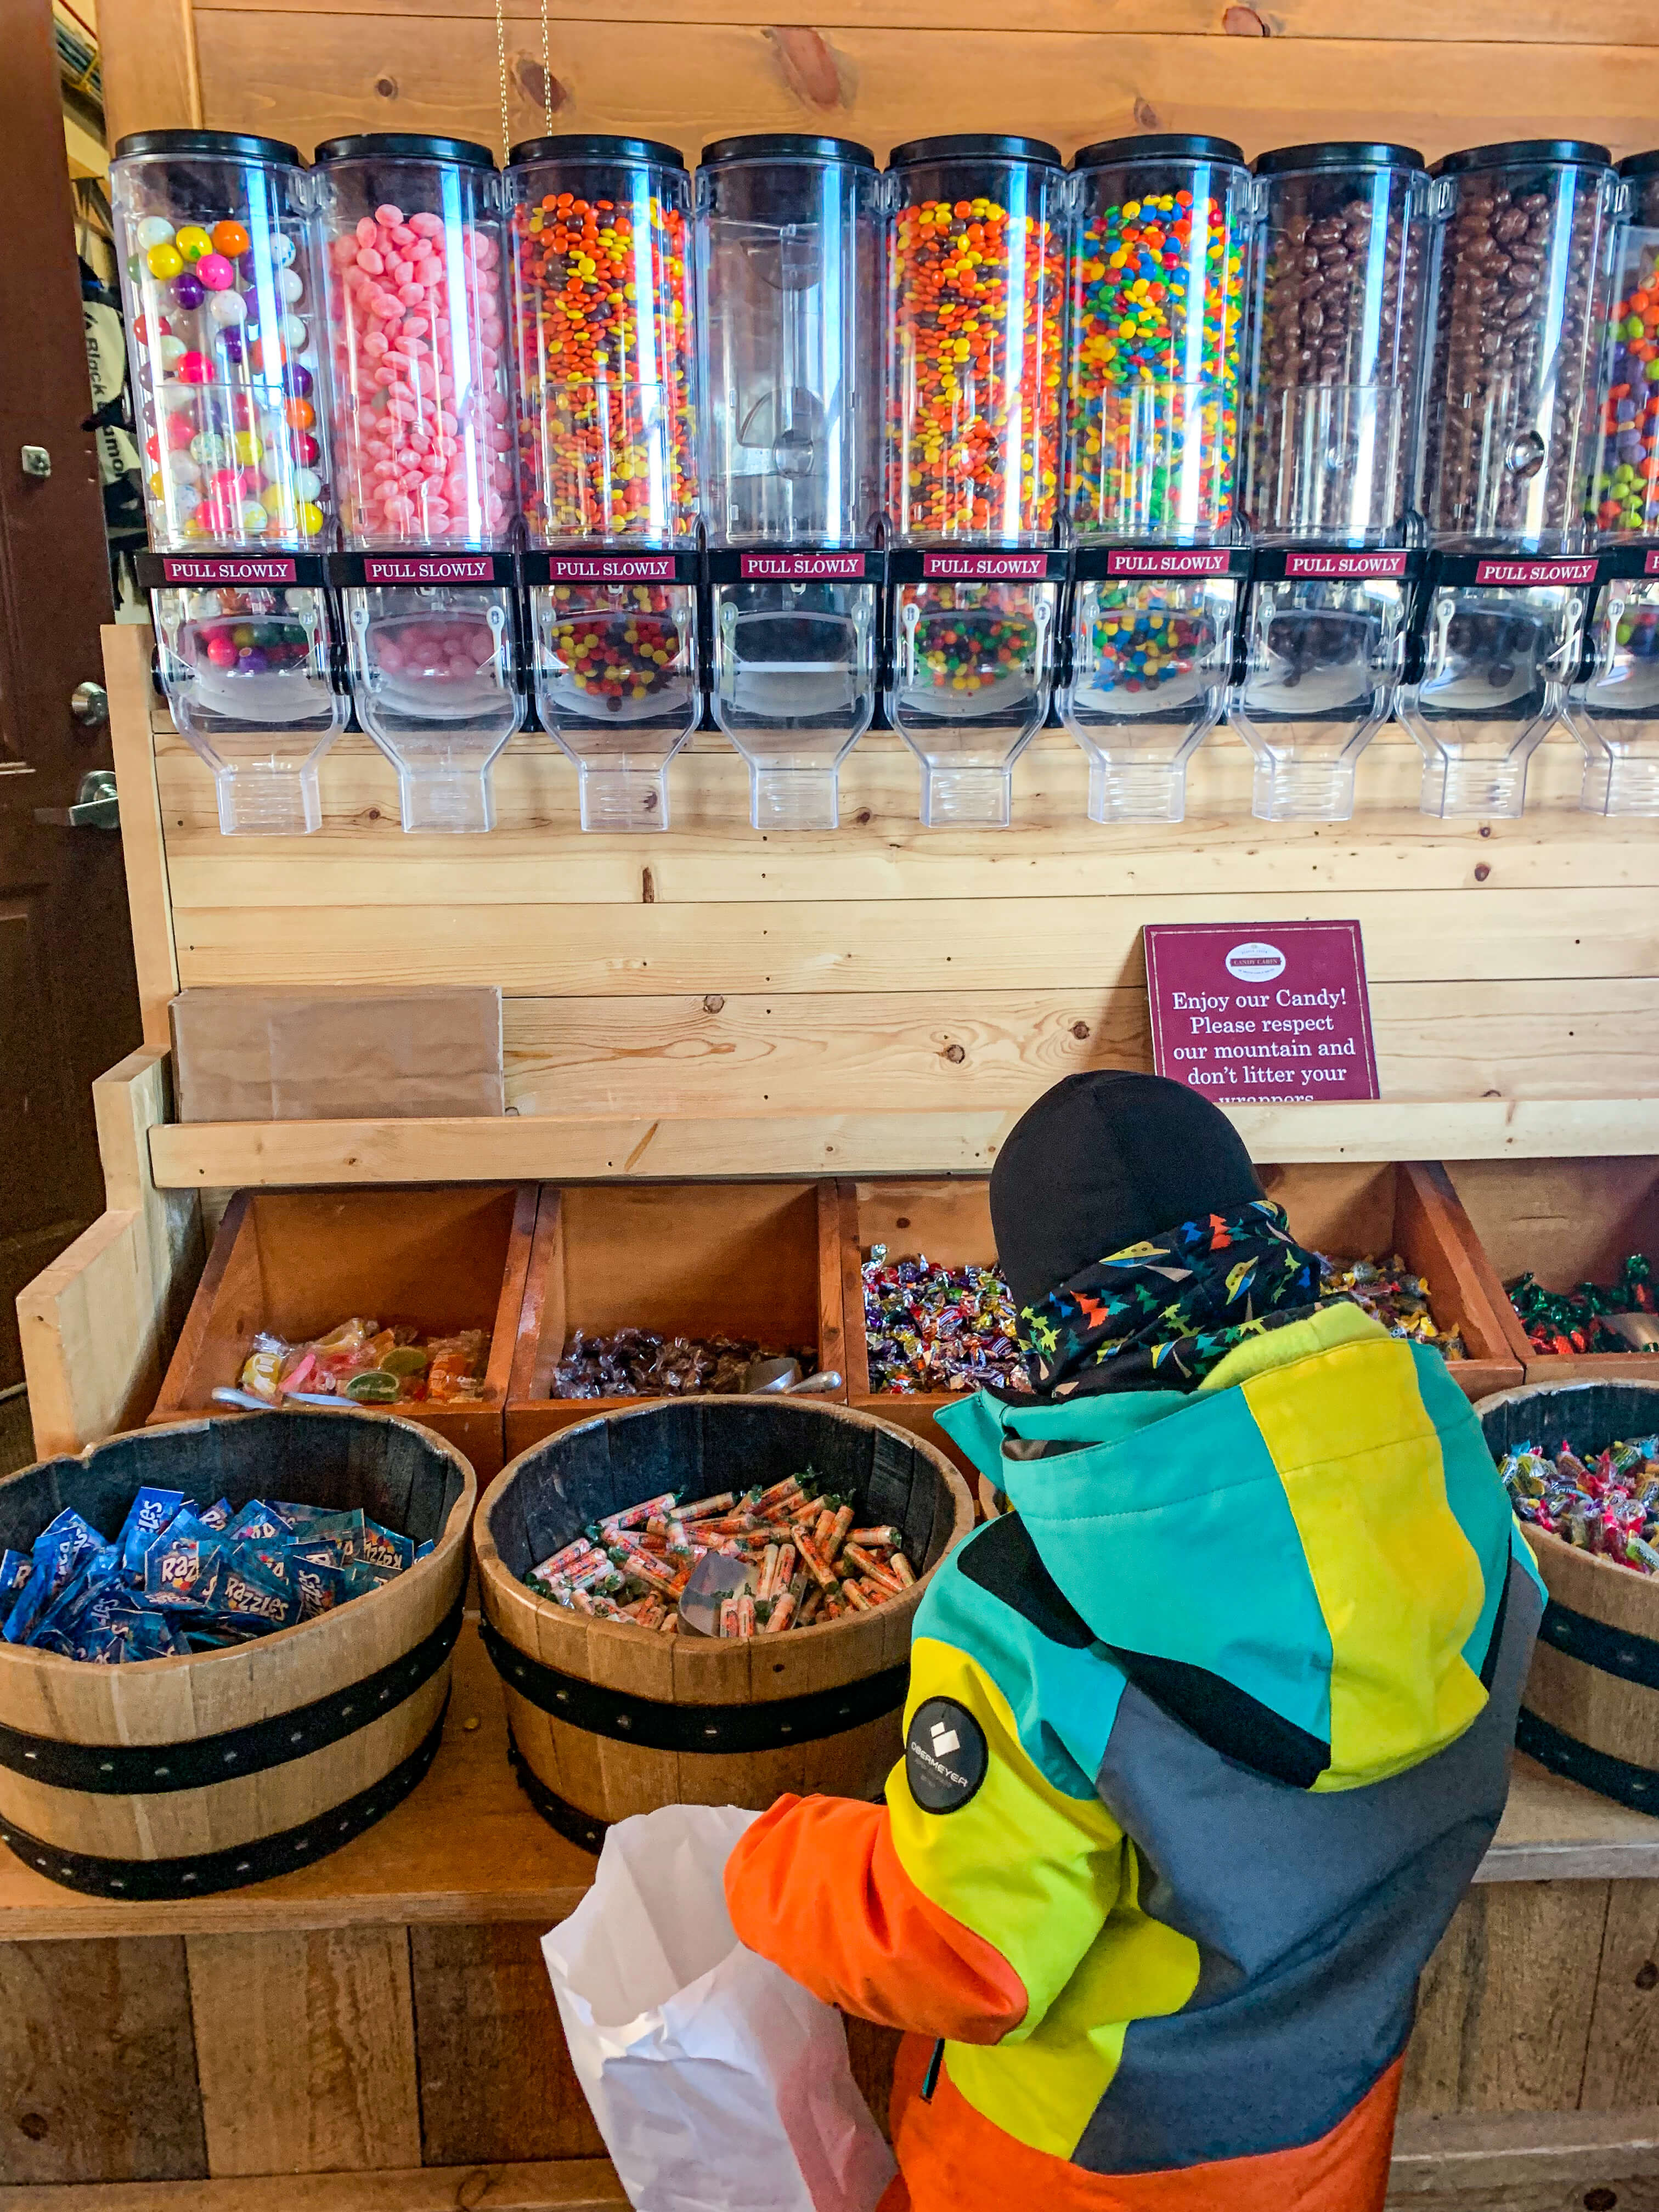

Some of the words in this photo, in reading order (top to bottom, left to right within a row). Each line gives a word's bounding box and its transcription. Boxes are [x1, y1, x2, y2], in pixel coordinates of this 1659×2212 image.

[86, 337, 108, 396] Black
[171, 564, 216, 577] PULL
[219, 564, 288, 577] SLOWLY
[371, 564, 416, 577] PULL
[419, 563, 486, 577] SLOWLY
[556, 563, 600, 575] PULL
[603, 562, 669, 575] SLOWLY
[748, 560, 791, 573] PULL
[794, 560, 859, 573] SLOWLY
[930, 560, 973, 573] PULL
[977, 560, 1041, 574] SLOWLY
[1114, 556, 1158, 570] PULL
[1161, 556, 1224, 570] SLOWLY
[1293, 558, 1336, 572] PULL
[1339, 557, 1401, 571] SLOWLY
[1483, 566, 1527, 580] PULL
[1530, 565, 1592, 580] SLOWLY
[1172, 991, 1229, 1013] Enjoy
[1235, 994, 1270, 1008] our
[1276, 988, 1347, 1009] Candy!
[1190, 1017, 1256, 1035] Please
[1262, 1015, 1334, 1035] respect
[1173, 1047, 1208, 1060] our
[1214, 1040, 1312, 1059] mountain
[1318, 1038, 1356, 1057] and
[1188, 1067, 1238, 1086] don't
[1242, 1066, 1295, 1084] litter
[1301, 1067, 1347, 1086] your
[224, 1576, 289, 1622] Razzles
[911, 1741, 968, 1787] OBERMEYER
